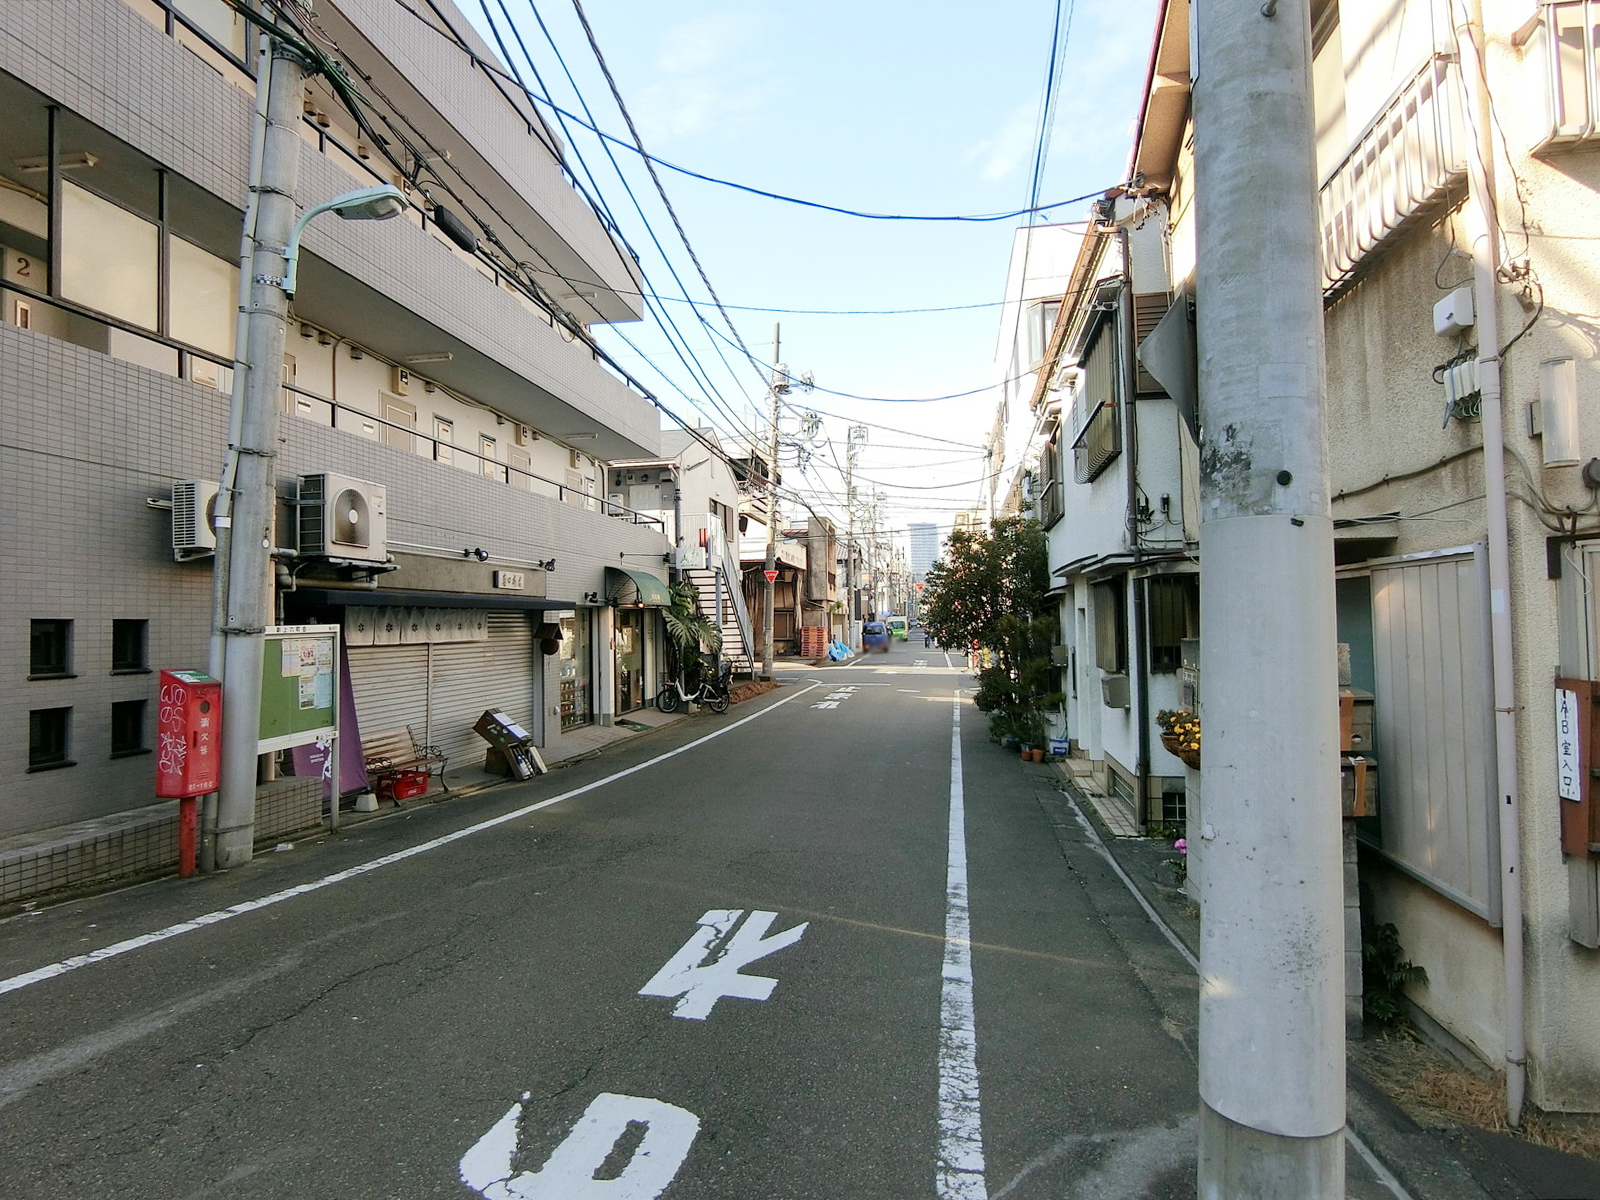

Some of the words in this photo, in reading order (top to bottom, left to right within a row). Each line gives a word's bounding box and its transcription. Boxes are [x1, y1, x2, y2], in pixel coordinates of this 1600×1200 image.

[17, 257, 30, 277] 2
[809, 686, 861, 710] 止まれ
